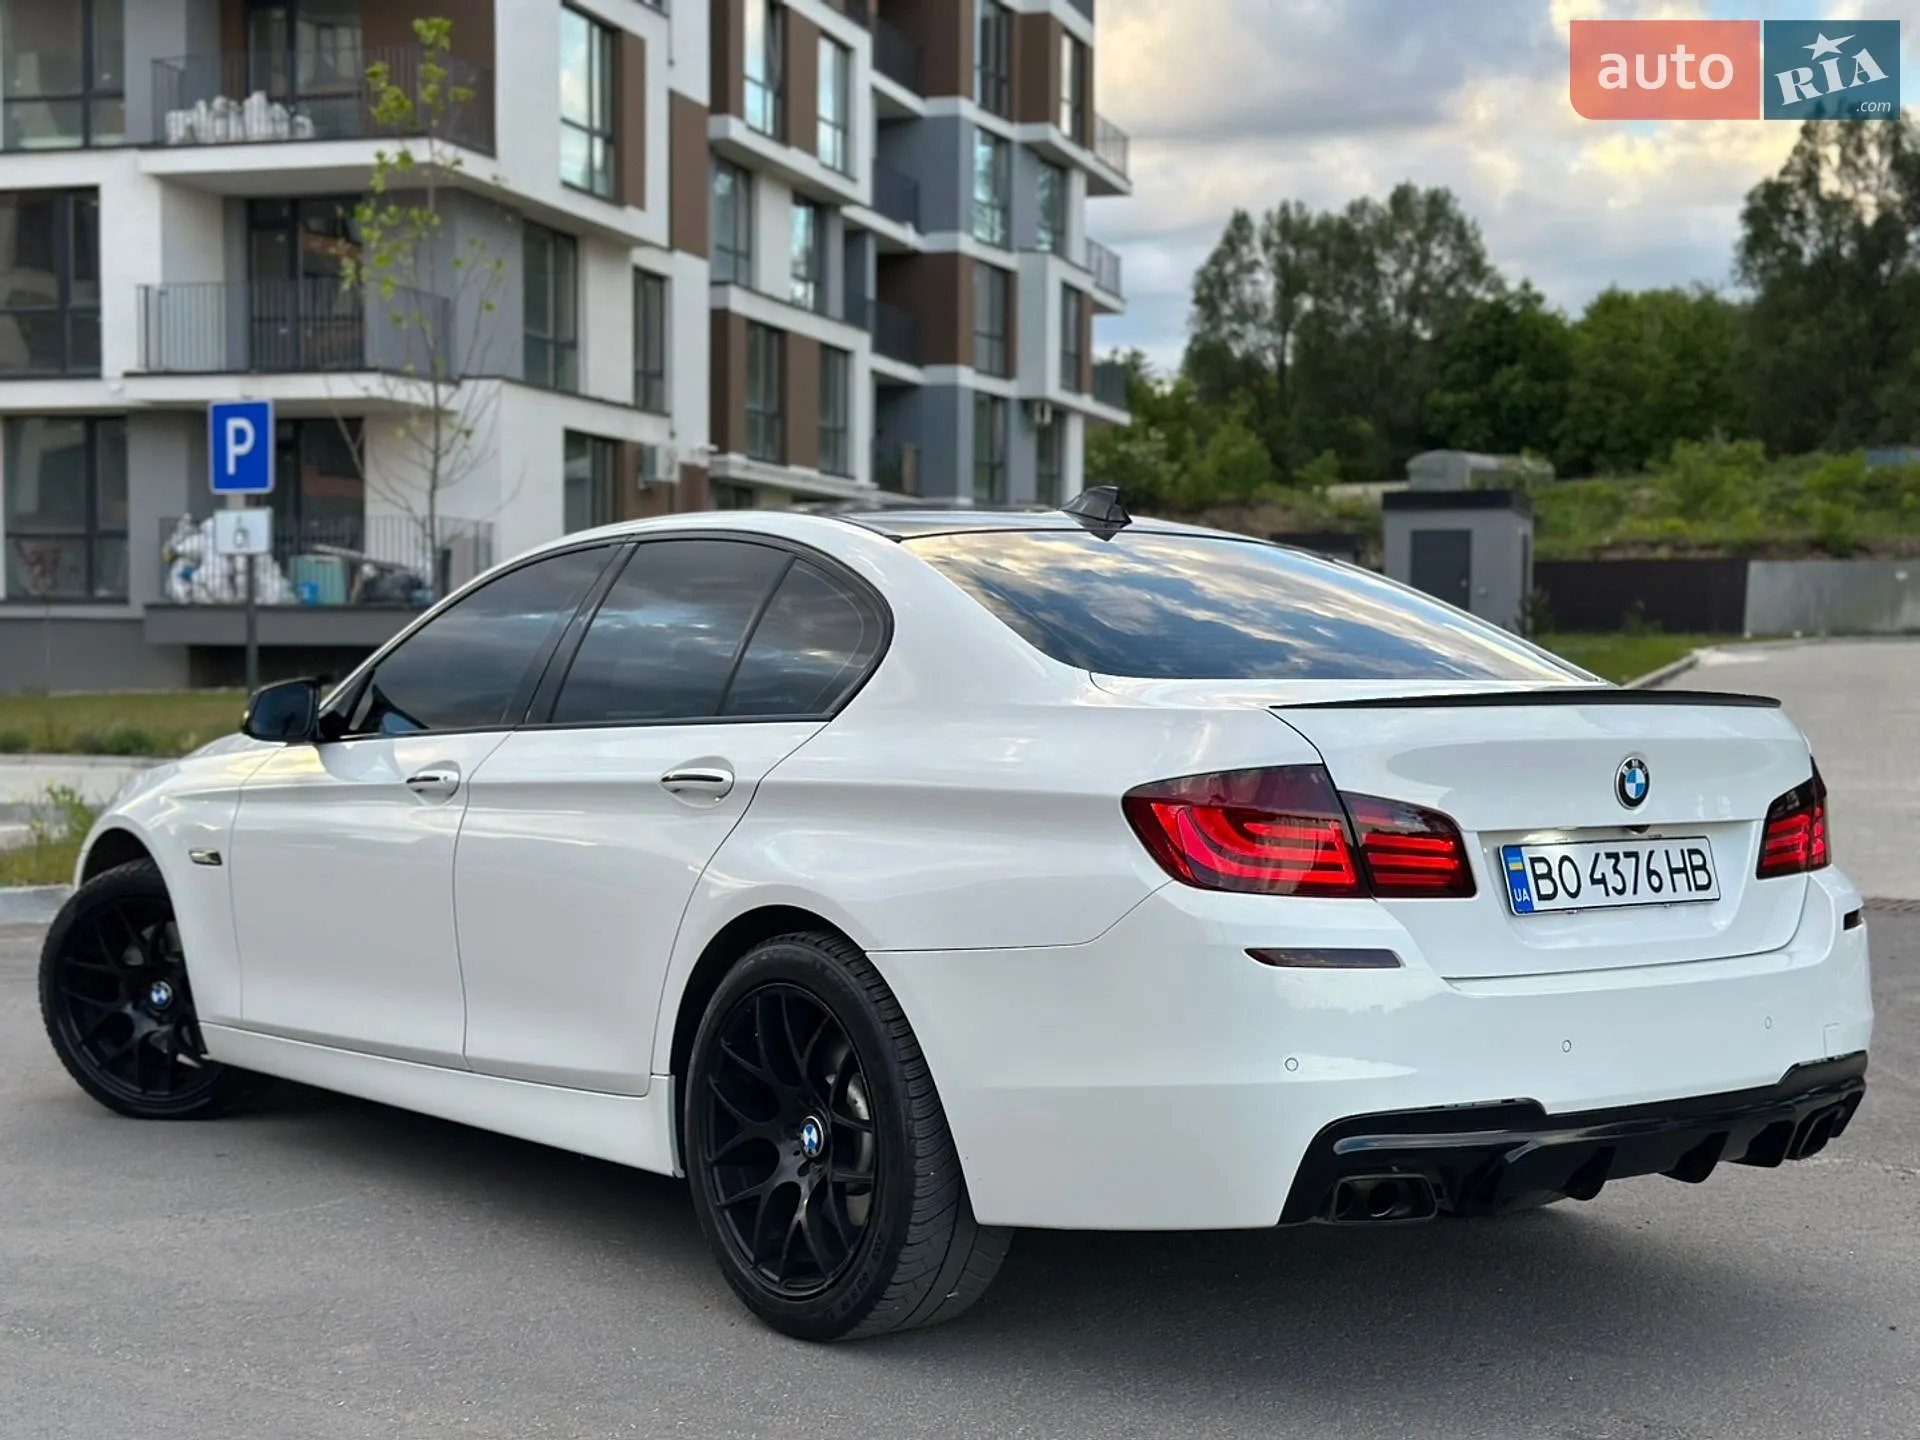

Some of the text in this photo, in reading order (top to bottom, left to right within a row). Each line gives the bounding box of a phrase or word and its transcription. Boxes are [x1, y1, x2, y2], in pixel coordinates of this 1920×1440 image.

[226, 417, 255, 475] P
[1513, 888, 1531, 902] UA
[1589, 850, 1663, 897] 4376
